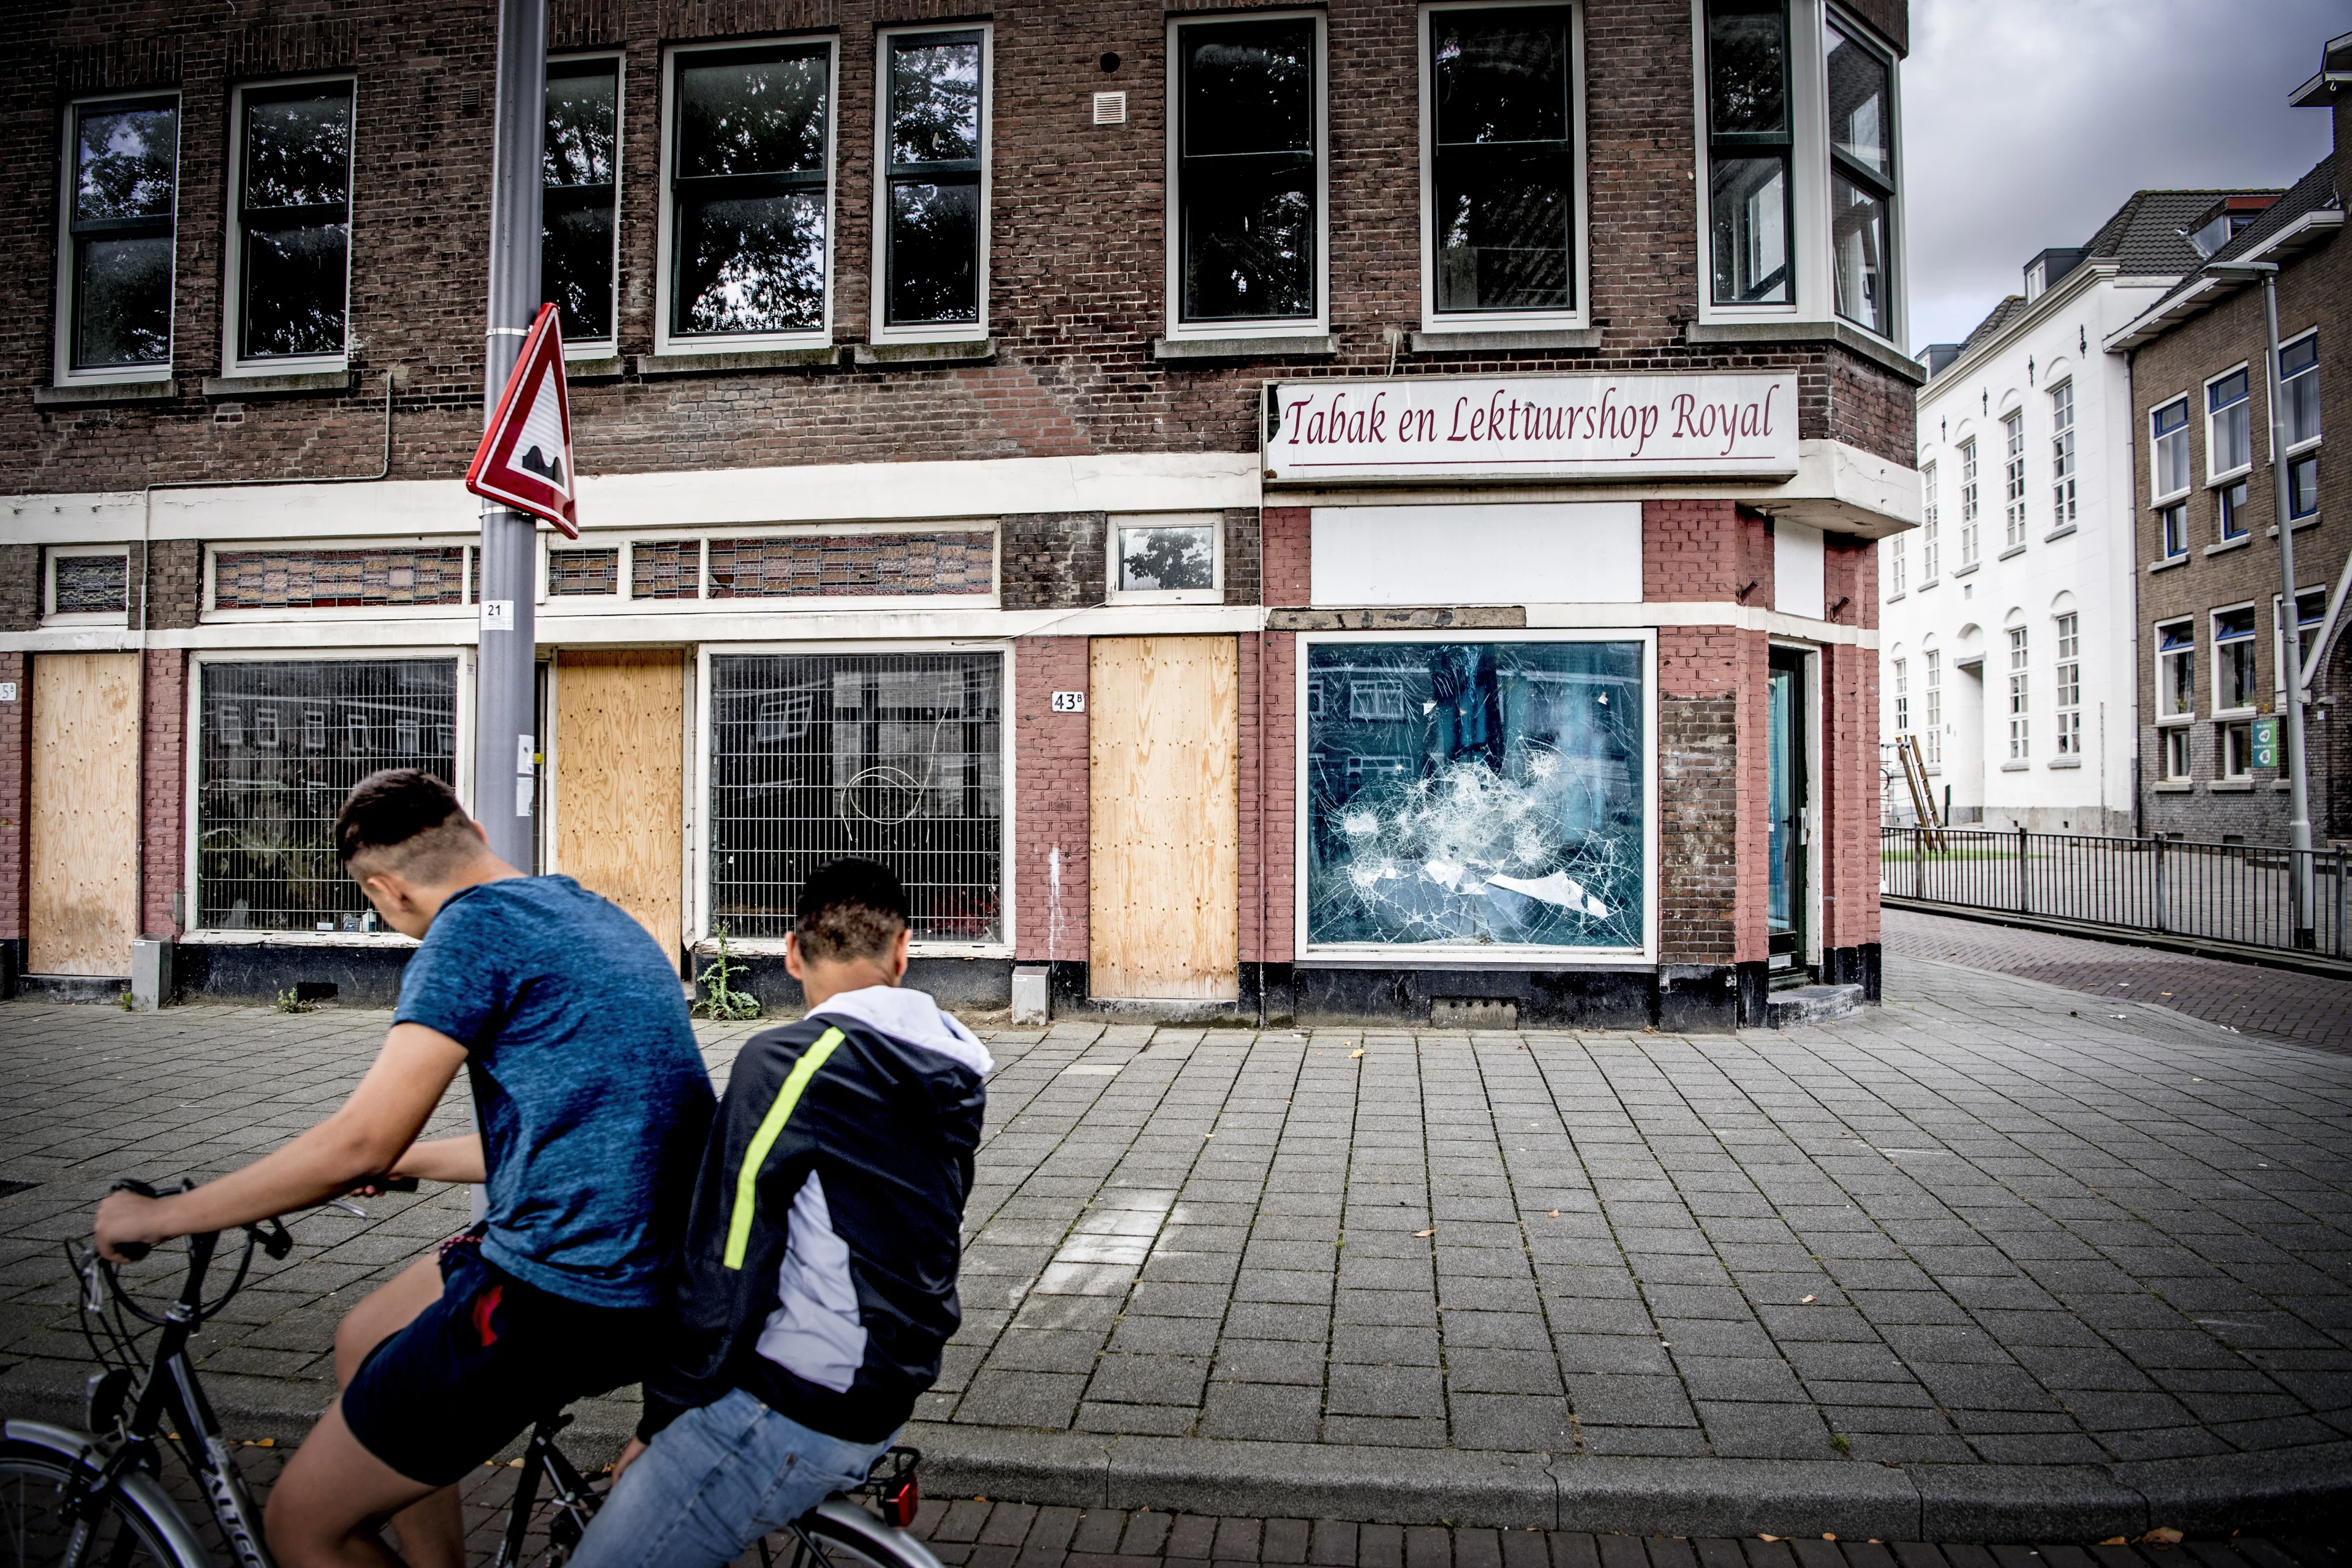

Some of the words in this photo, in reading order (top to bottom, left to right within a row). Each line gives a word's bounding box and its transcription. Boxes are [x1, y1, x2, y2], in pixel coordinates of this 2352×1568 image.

[1284, 391, 1387, 445] Tabak
[1398, 409, 1438, 443] en
[1447, 386, 1659, 458] Lektuurshop
[1671, 383, 1781, 456] Royal
[488, 604, 500, 616] 21
